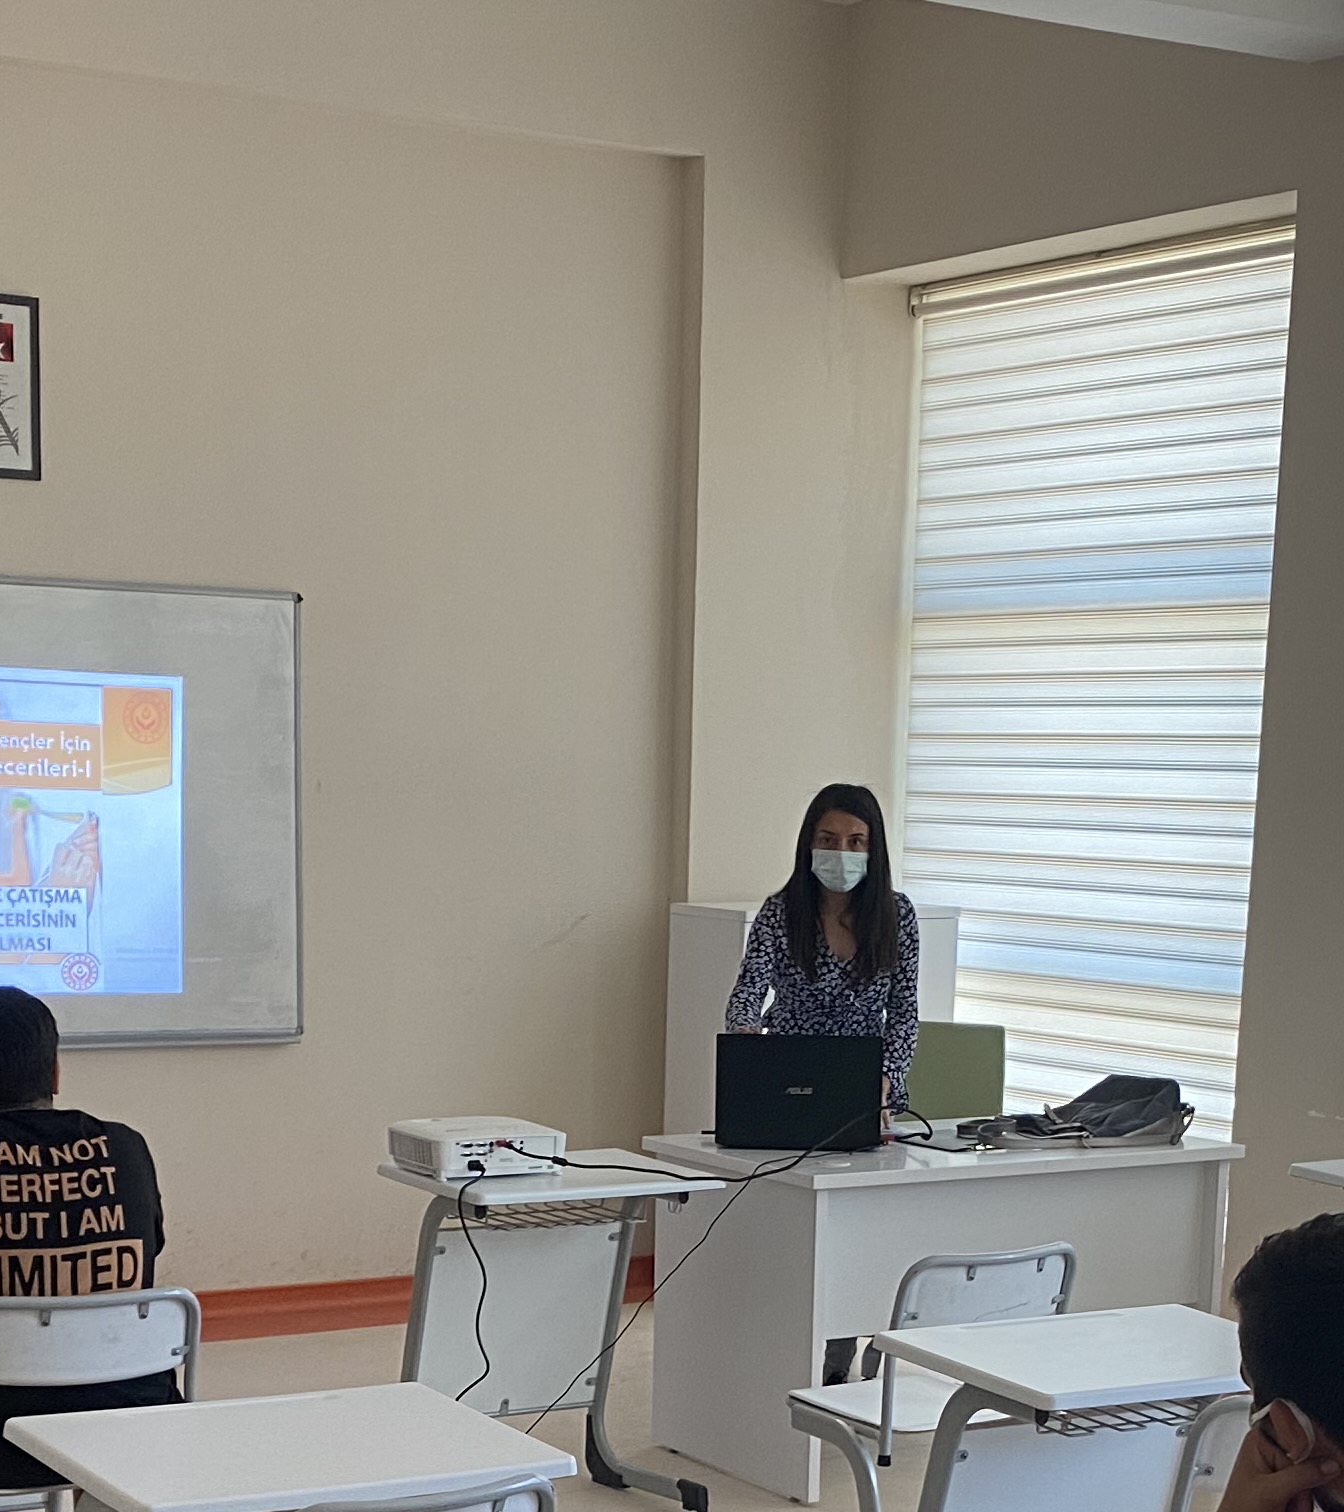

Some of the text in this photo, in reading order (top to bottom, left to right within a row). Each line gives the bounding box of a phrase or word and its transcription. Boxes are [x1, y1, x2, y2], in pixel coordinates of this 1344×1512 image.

[59, 730, 91, 754] İçin
[6, 888, 83, 909] ÇATIŞMA
[48, 1135, 110, 1167] NOT
[59, 1210, 69, 1239] I
[78, 1203, 126, 1237] AM
